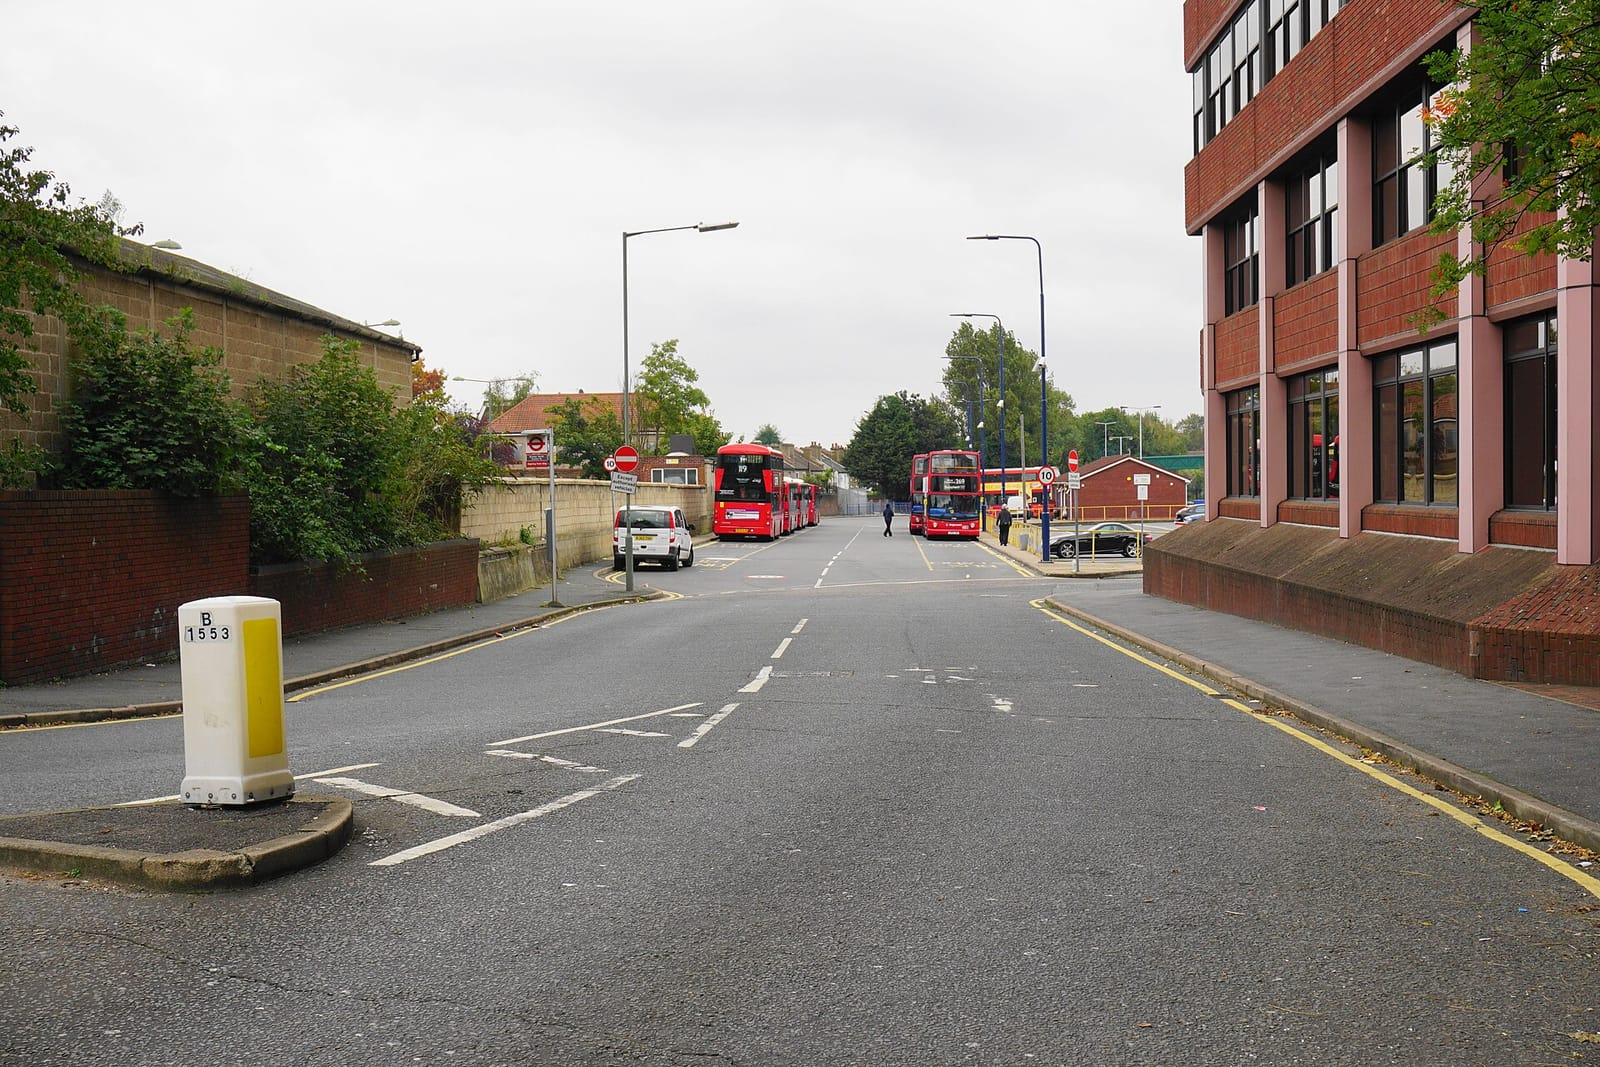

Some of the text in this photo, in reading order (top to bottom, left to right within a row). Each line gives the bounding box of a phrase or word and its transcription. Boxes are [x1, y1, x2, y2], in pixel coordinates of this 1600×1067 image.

[606, 460, 615, 468] 10
[617, 474, 633, 482] Except
[1041, 471, 1052, 480] 10
[202, 612, 212, 626] B
[187, 627, 229, 641] 1553
